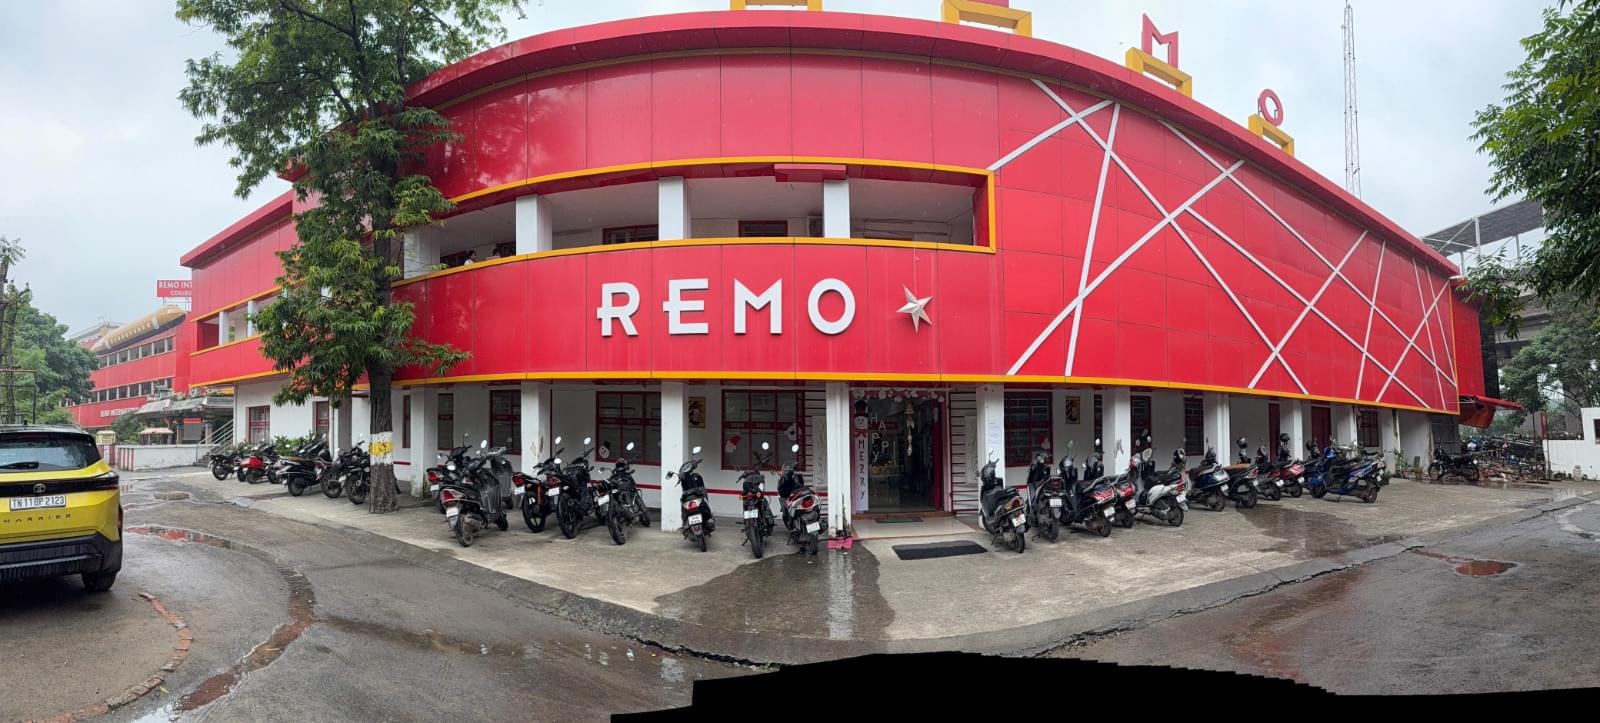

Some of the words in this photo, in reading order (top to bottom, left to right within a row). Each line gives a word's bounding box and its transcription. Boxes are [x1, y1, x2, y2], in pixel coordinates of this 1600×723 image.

[158, 280, 180, 289] REMO
[597, 278, 856, 337] REMO
[858, 439, 866, 500] MERRY
